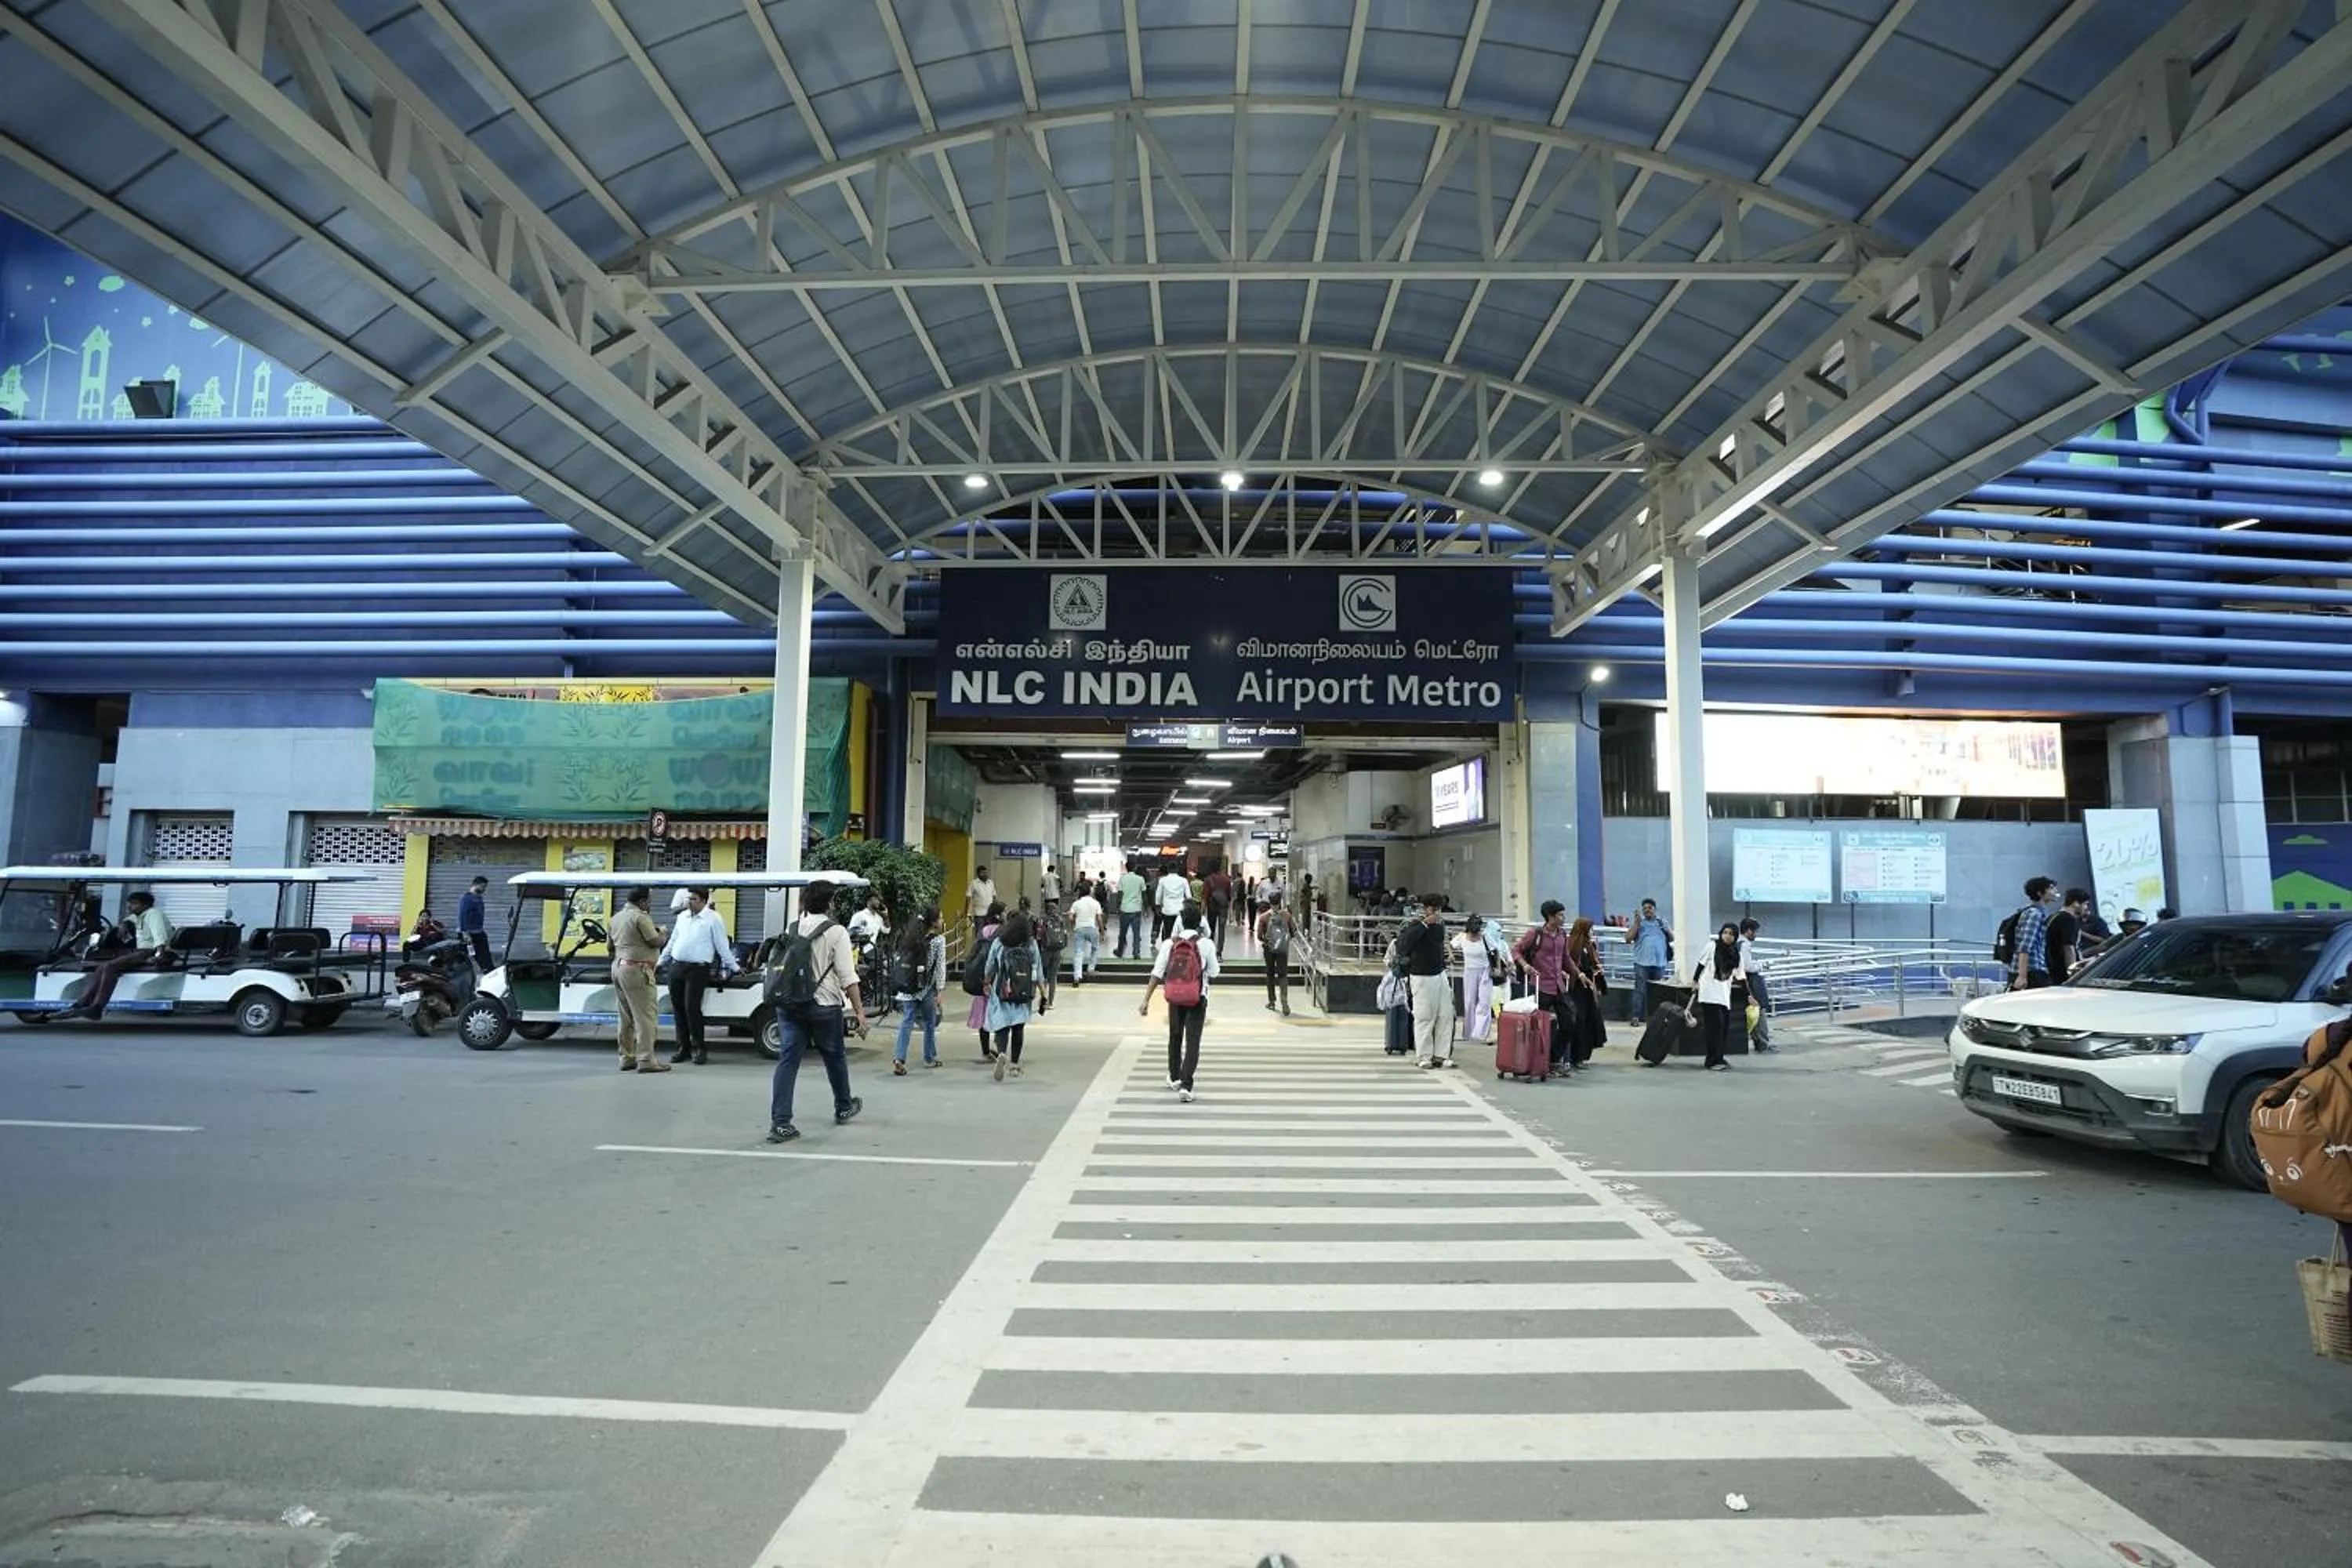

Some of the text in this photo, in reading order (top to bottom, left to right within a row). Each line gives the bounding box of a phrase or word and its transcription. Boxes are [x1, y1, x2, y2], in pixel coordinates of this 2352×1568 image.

[955, 637, 1191, 664] என்எல்சி இந்தியா
[1236, 637, 1501, 665] விமானநிலையம் மெட்ரோ
[951, 670, 1200, 706] NLC INDIA
[1236, 668, 1502, 711] Airport Metro
